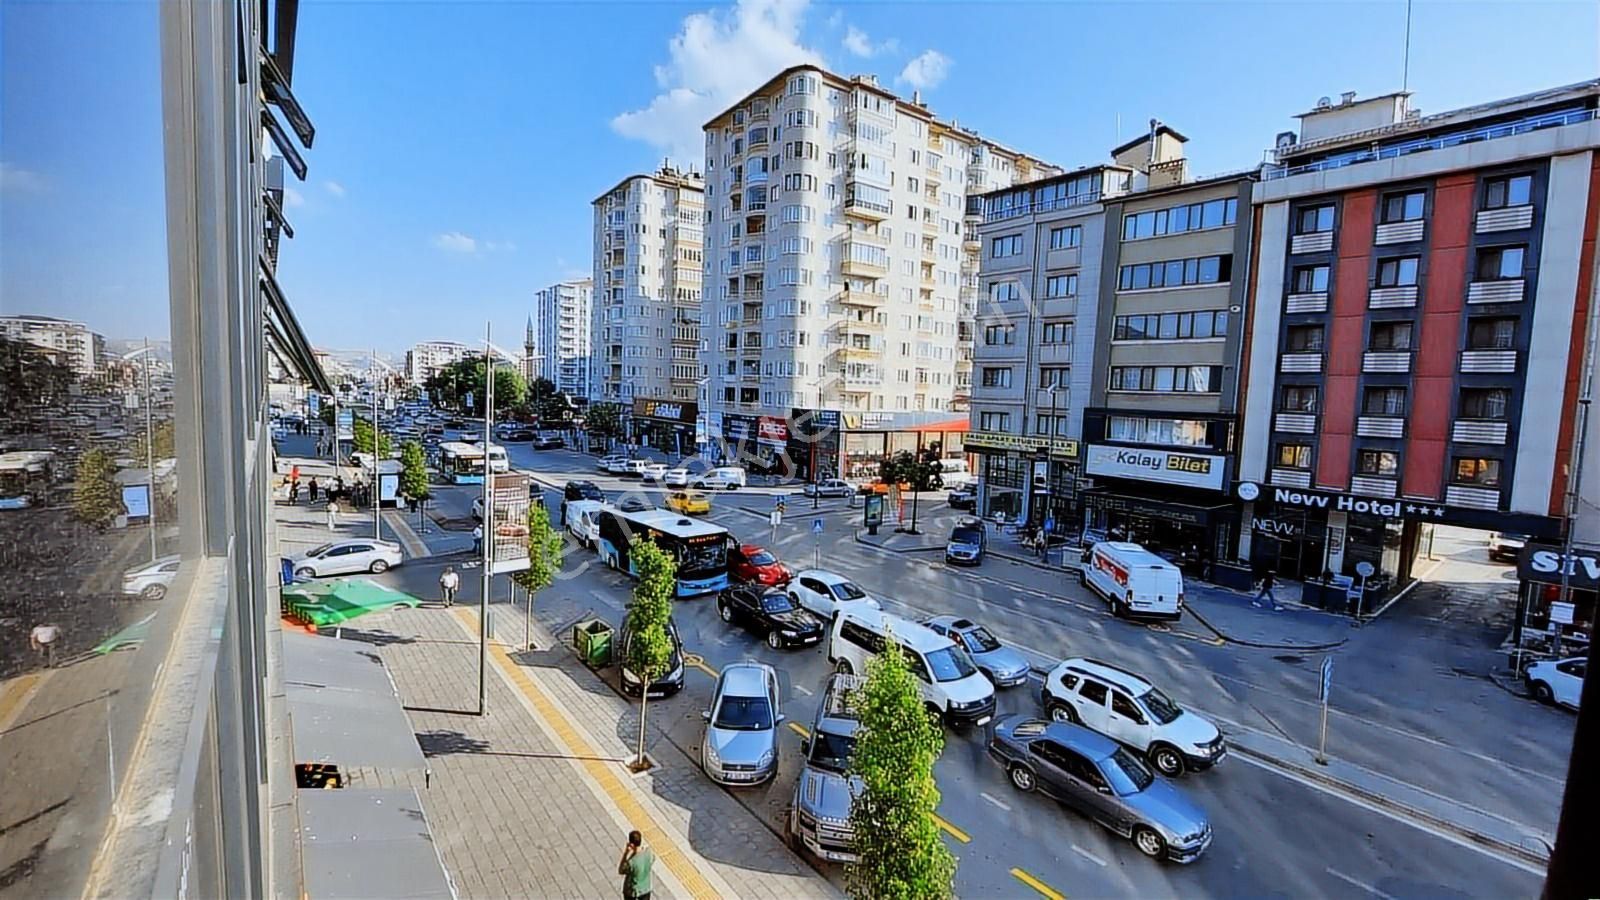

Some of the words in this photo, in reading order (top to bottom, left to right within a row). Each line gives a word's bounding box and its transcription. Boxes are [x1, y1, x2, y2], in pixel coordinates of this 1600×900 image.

[1117, 450, 1162, 471] Kolay
[1167, 455, 1210, 473] Bilet
[1274, 488, 1329, 508] Nevv
[1337, 496, 1401, 518] Hotel
